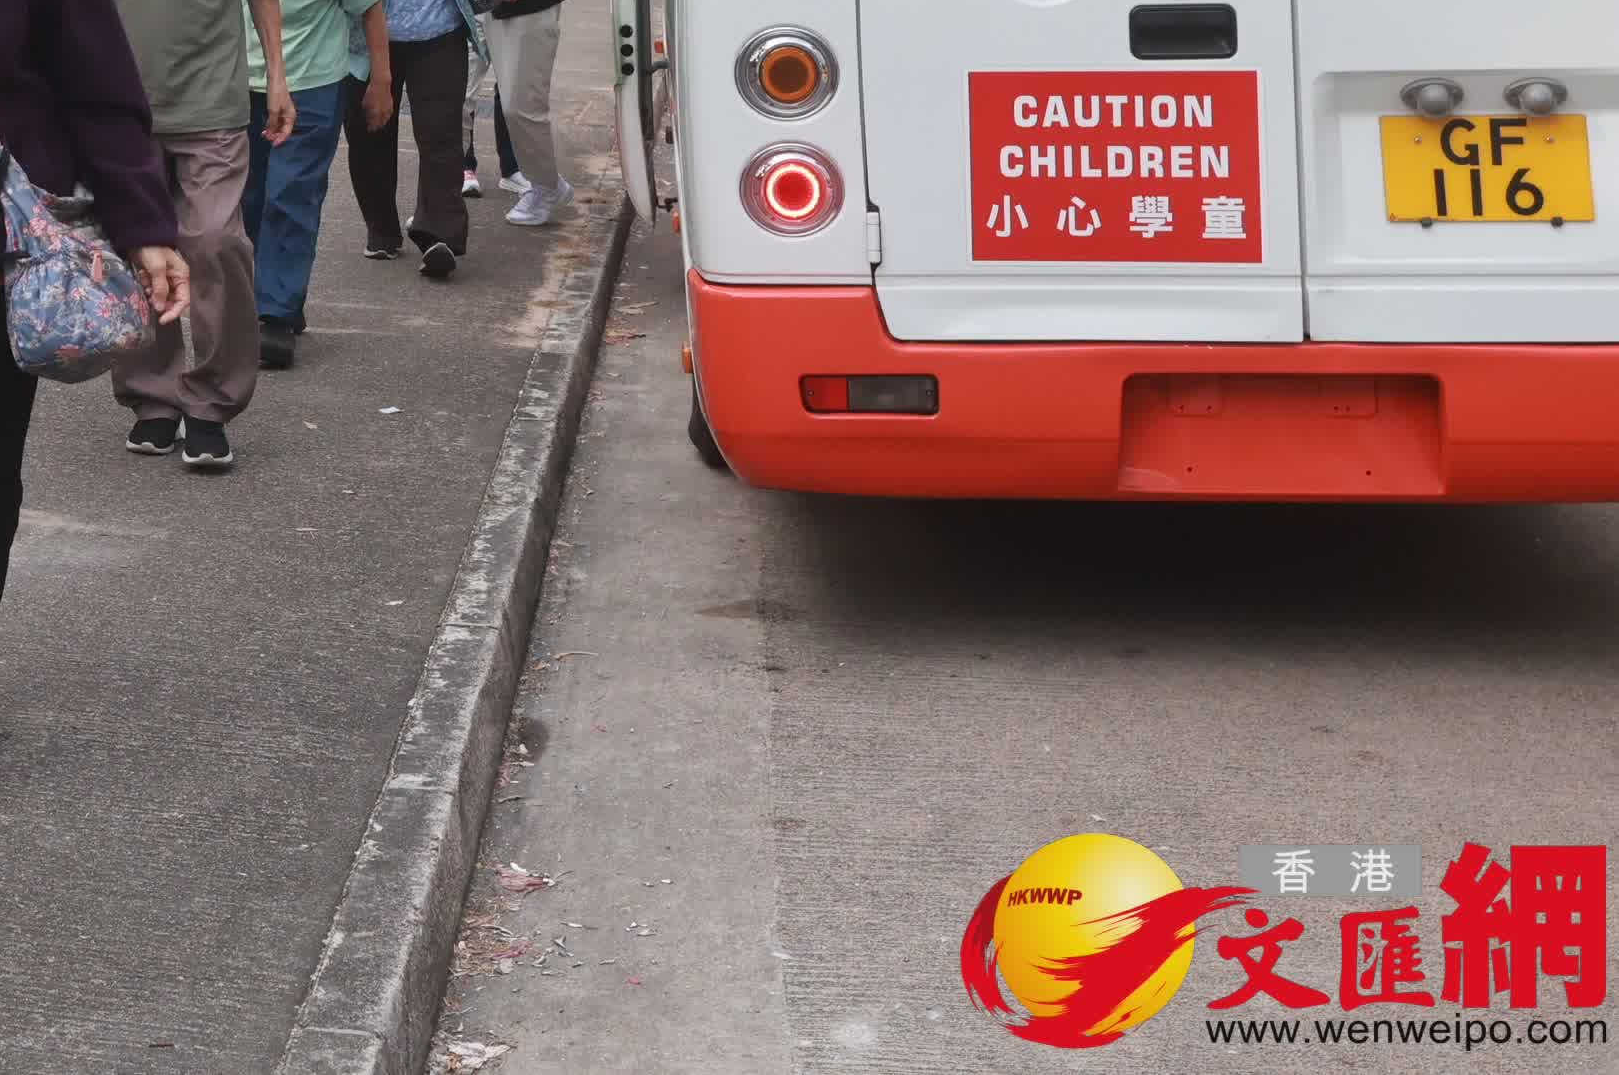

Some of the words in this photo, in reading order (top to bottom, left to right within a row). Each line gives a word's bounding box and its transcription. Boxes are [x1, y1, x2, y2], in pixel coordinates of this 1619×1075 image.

[1013, 94, 1215, 129] CAUTION
[999, 144, 1231, 179] CHILDREN
[1440, 117, 1527, 166] GF
[1433, 169, 1545, 217] 116
[986, 195, 1247, 241] 小心學童
